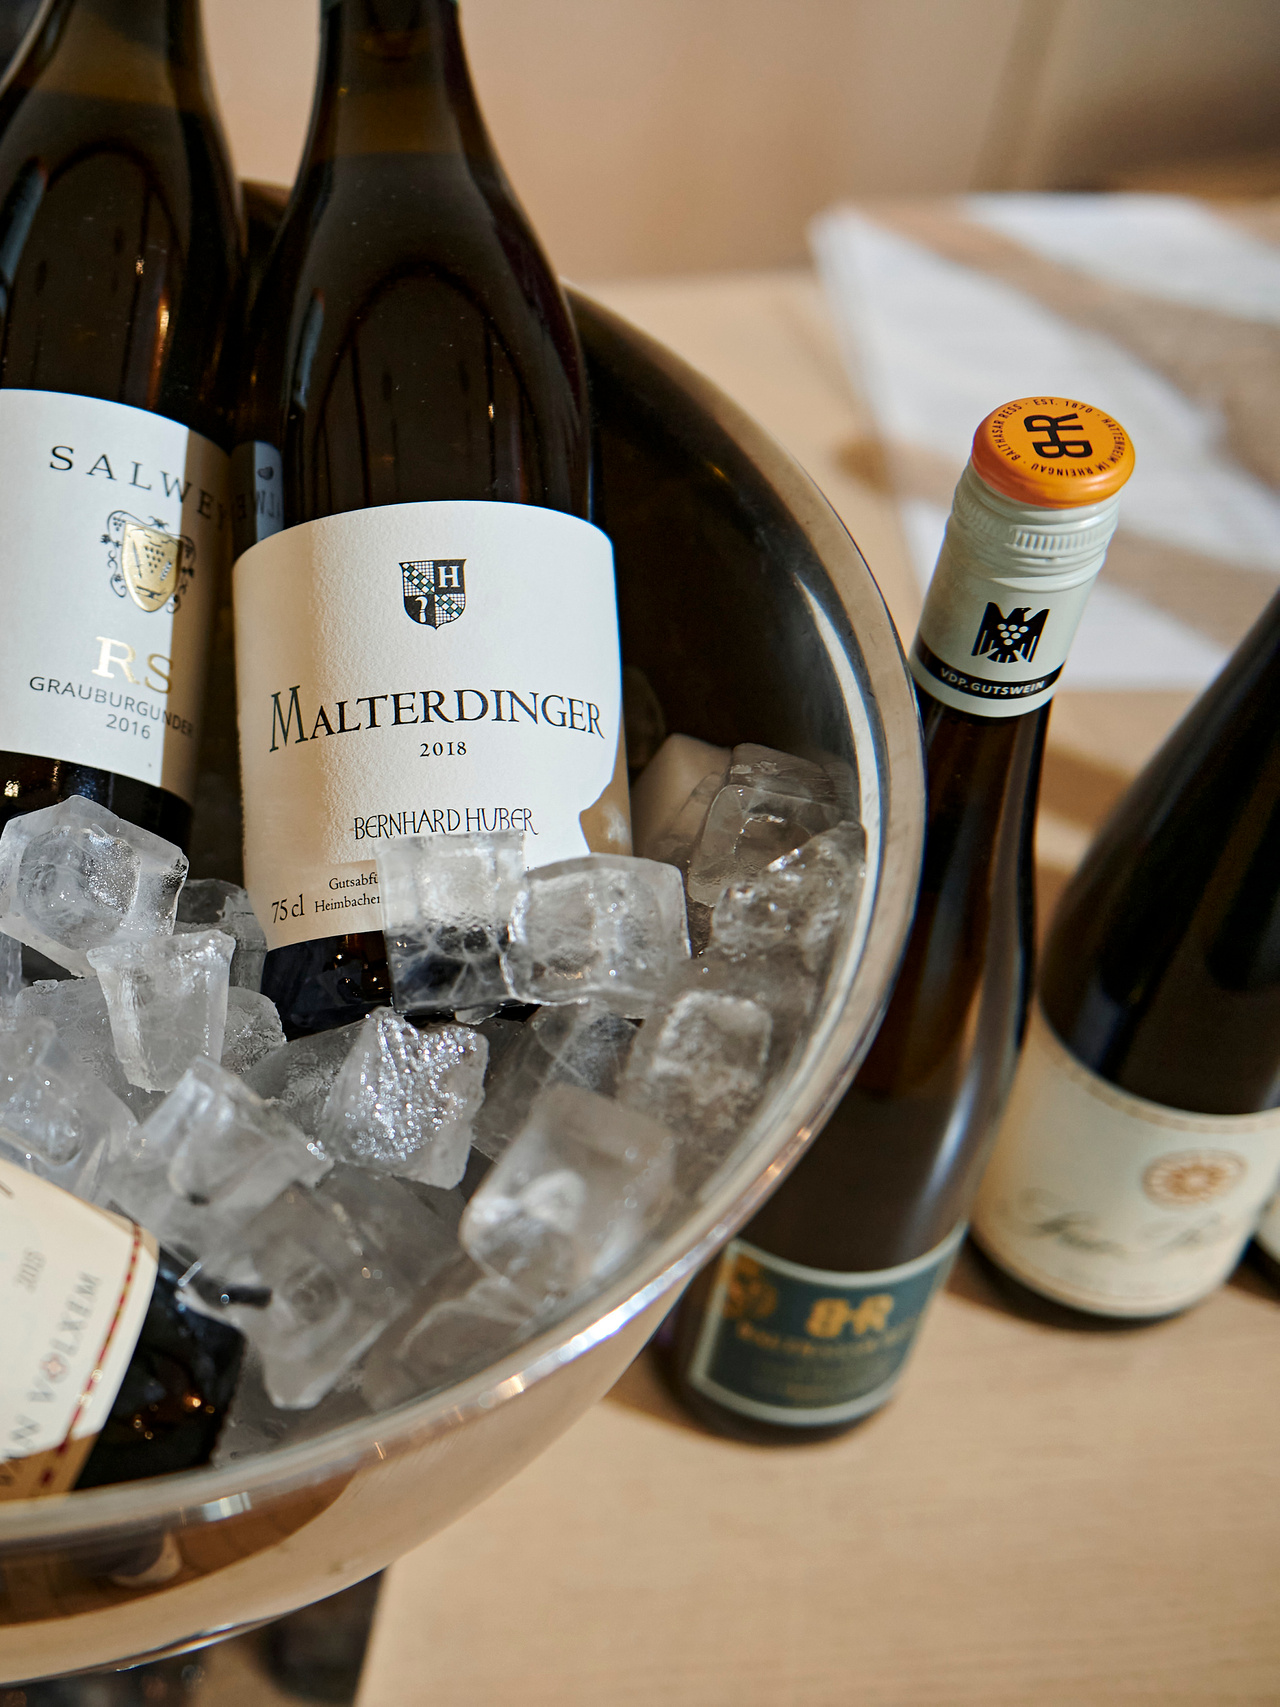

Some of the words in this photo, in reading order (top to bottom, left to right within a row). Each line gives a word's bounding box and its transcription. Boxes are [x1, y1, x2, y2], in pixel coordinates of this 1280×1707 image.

[998, 402, 1023, 420] RESS
[1032, 398, 1059, 407] EST.
[1065, 400, 1094, 415] 1870
[991, 419, 1022, 462] BALTHASAR
[1030, 463, 1094, 478] RHEINGAU
[437, 564, 462, 590] H
[939, 666, 1045, 697] VDP.GUTSWEIN
[28, 675, 195, 739] GRAUBURGUNDER
[268, 684, 606, 754] MALTERDINGER
[105, 713, 152, 740] 2016
[418, 741, 468, 758] 2018
[353, 808, 462, 841] BERNHARD
[465, 806, 540, 836] HUBER
[271, 898, 288, 924] 75
[291, 893, 306, 918] cl
